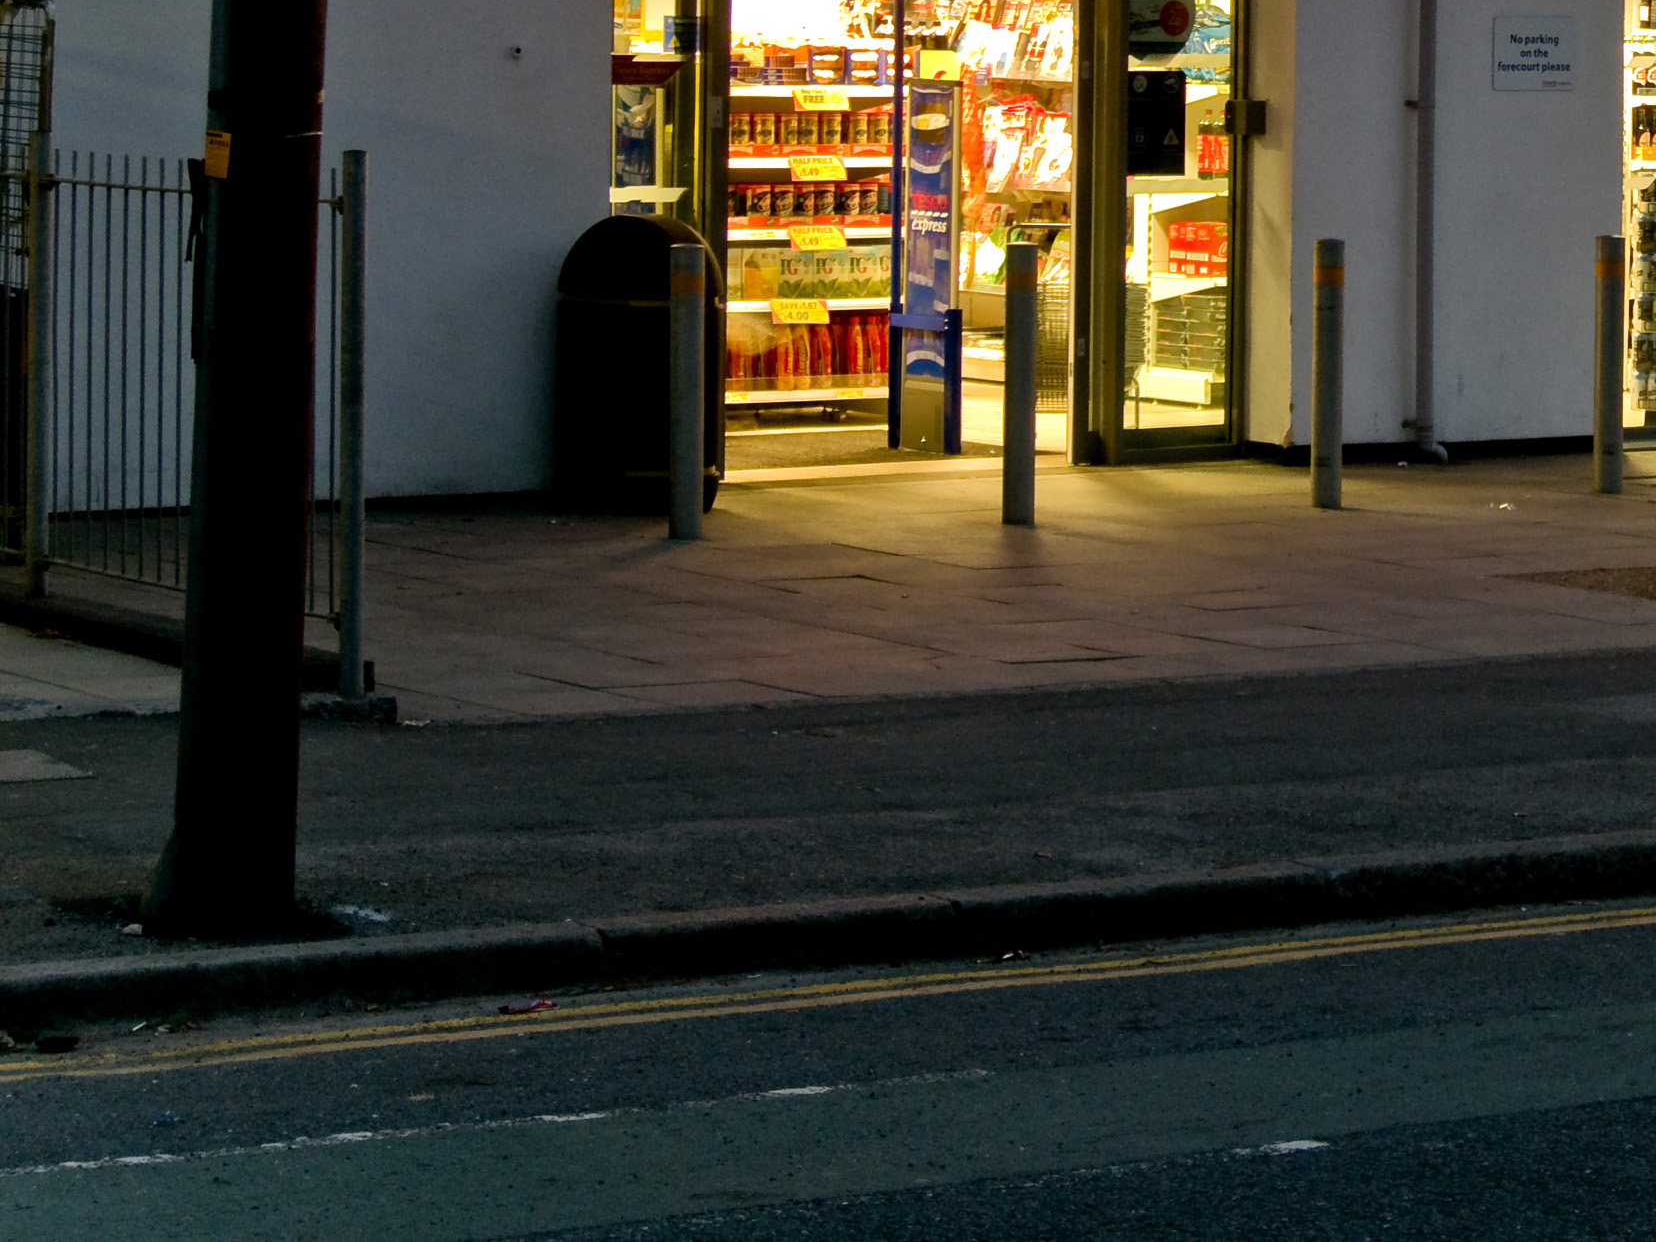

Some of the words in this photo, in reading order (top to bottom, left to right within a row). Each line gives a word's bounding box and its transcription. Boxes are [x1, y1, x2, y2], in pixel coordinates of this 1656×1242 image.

[1510, 33, 1523, 45] No
[1524, 34, 1560, 46] parking
[1520, 49, 1532, 58] on
[1533, 48, 1549, 58] the
[1497, 61, 1541, 72] forecourt
[1541, 61, 1571, 73] please
[803, 94, 825, 104] FREE
[792, 157, 812, 165] HALF
[812, 157, 833, 165] PRICE
[911, 192, 949, 209] TESCO
[792, 226, 811, 234] HALF
[812, 226, 833, 235] PRICE
[911, 218, 948, 235] express
[779, 302, 798, 310] SAVE
